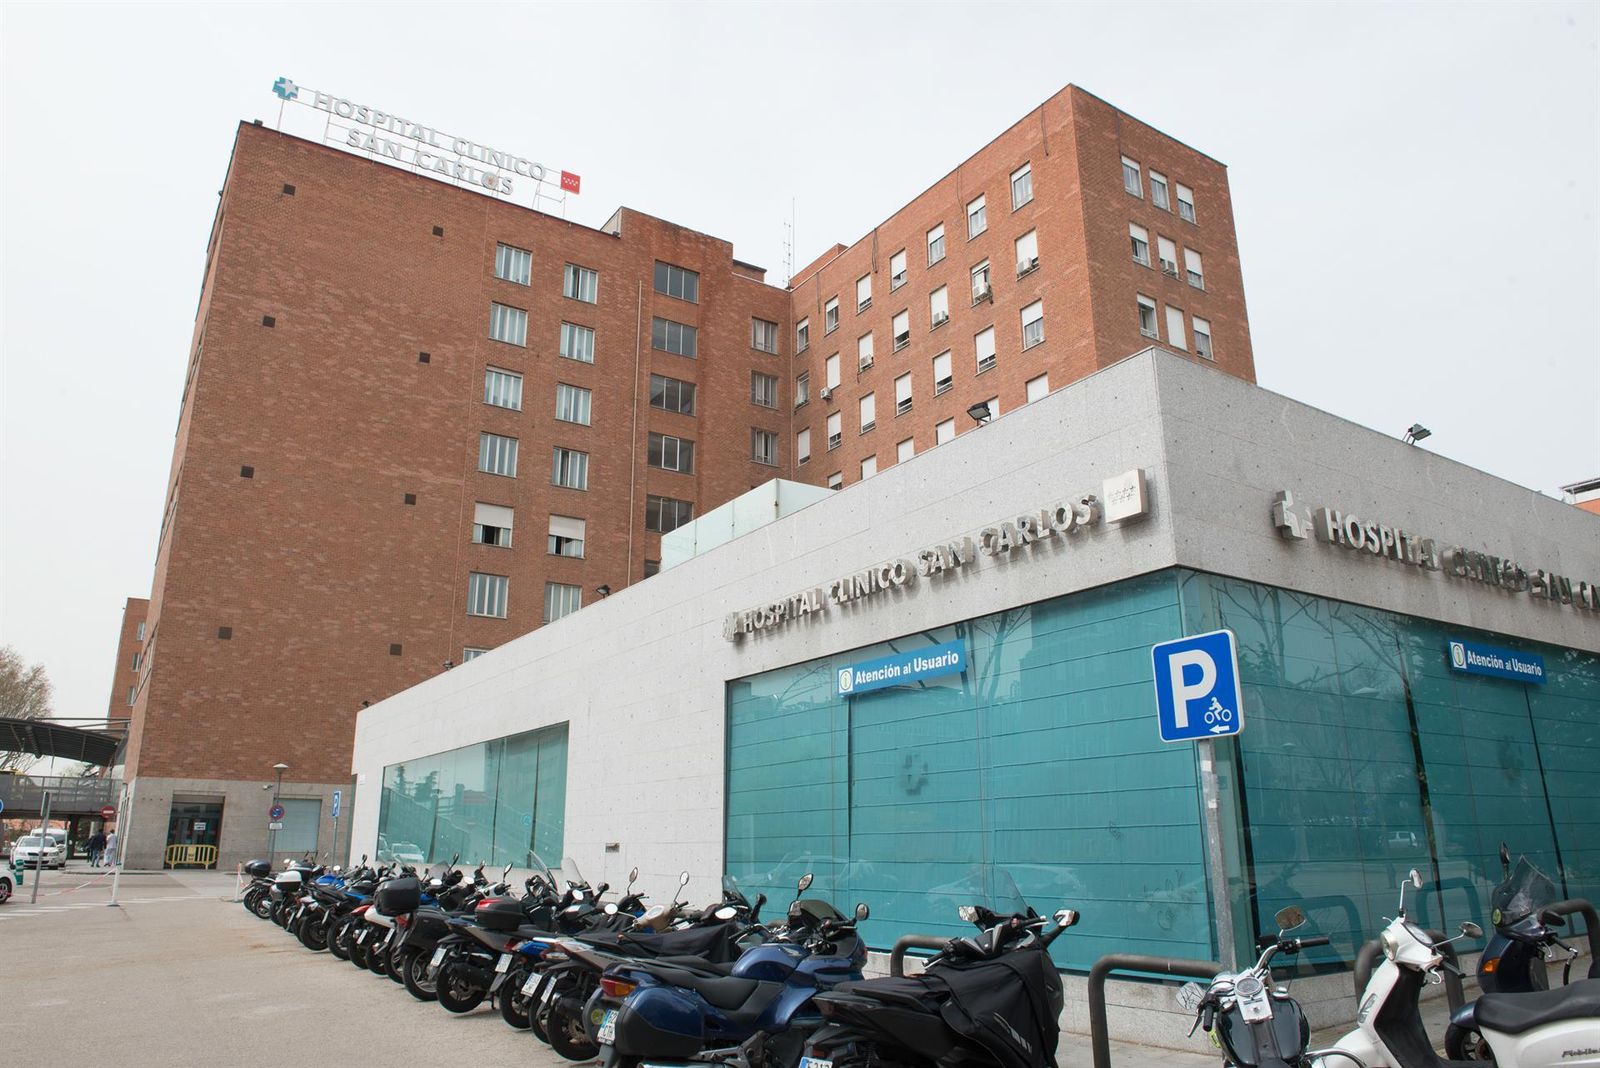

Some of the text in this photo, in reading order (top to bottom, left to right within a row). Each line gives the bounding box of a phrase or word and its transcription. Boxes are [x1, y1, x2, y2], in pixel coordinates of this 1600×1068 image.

[313, 90, 547, 181] HOSPITAL CLINICO
[345, 128, 514, 196] SAN CARLOS
[742, 494, 1100, 634] HOSPITAL CLINICO SAN CARLOS
[855, 650, 959, 686] Atención al Usuario
[1168, 649, 1217, 729] P
[1467, 650, 1542, 676] Atención al Usuario
